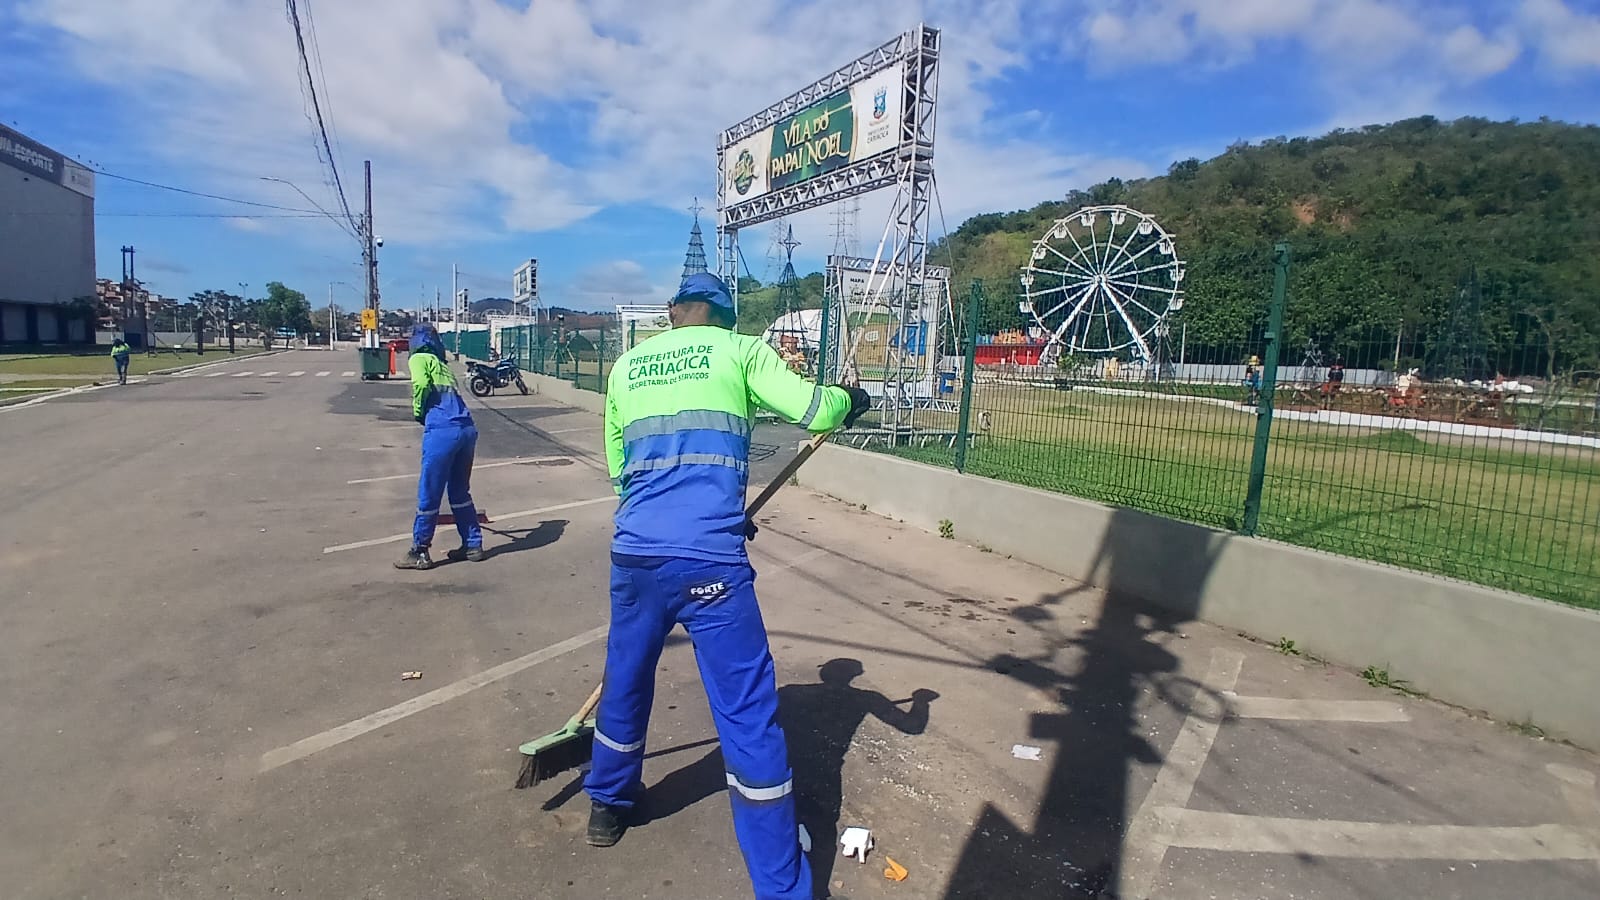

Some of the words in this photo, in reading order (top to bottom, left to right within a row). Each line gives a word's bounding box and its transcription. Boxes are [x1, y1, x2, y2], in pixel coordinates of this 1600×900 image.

[783, 119, 811, 148] VILA
[813, 115, 829, 133] DO
[772, 147, 803, 178] PAPAI
[805, 131, 849, 165] NOEL
[628, 355, 710, 381] CARIACICA
[629, 345, 694, 367] PREFEITURA
[697, 345, 714, 354] DE
[628, 379, 669, 391] SECRETARIA
[678, 372, 709, 382] SERVIÇOS
[690, 582, 725, 595] FORTE
